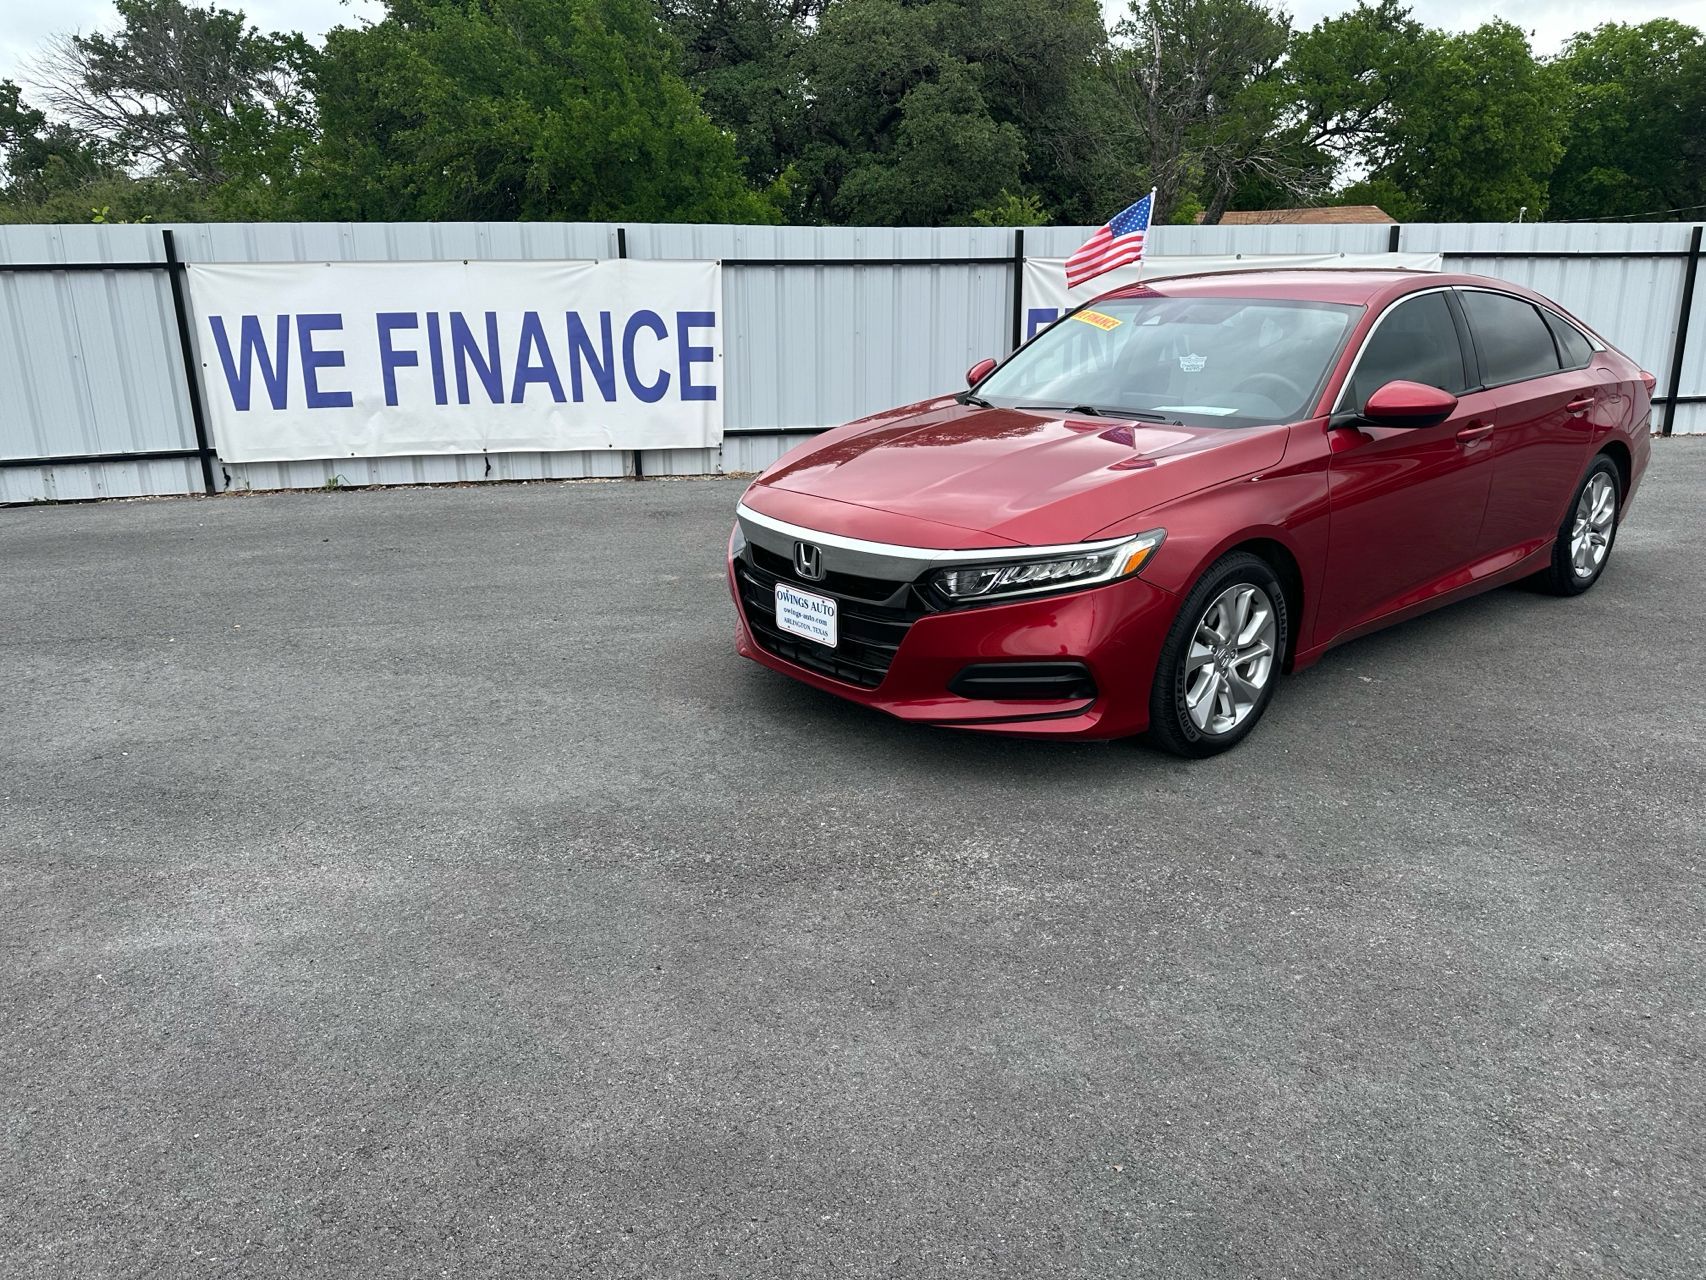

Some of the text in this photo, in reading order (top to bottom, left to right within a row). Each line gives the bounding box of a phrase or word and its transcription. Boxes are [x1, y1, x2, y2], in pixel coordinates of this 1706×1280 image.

[208, 309, 717, 411] WE FINANCE
[777, 590, 835, 617] OWINGS AUTO
[783, 606, 828, 627] owings-auto.com
[813, 625, 829, 637] TEXAS
[1275, 592, 1287, 643] RELIANT
